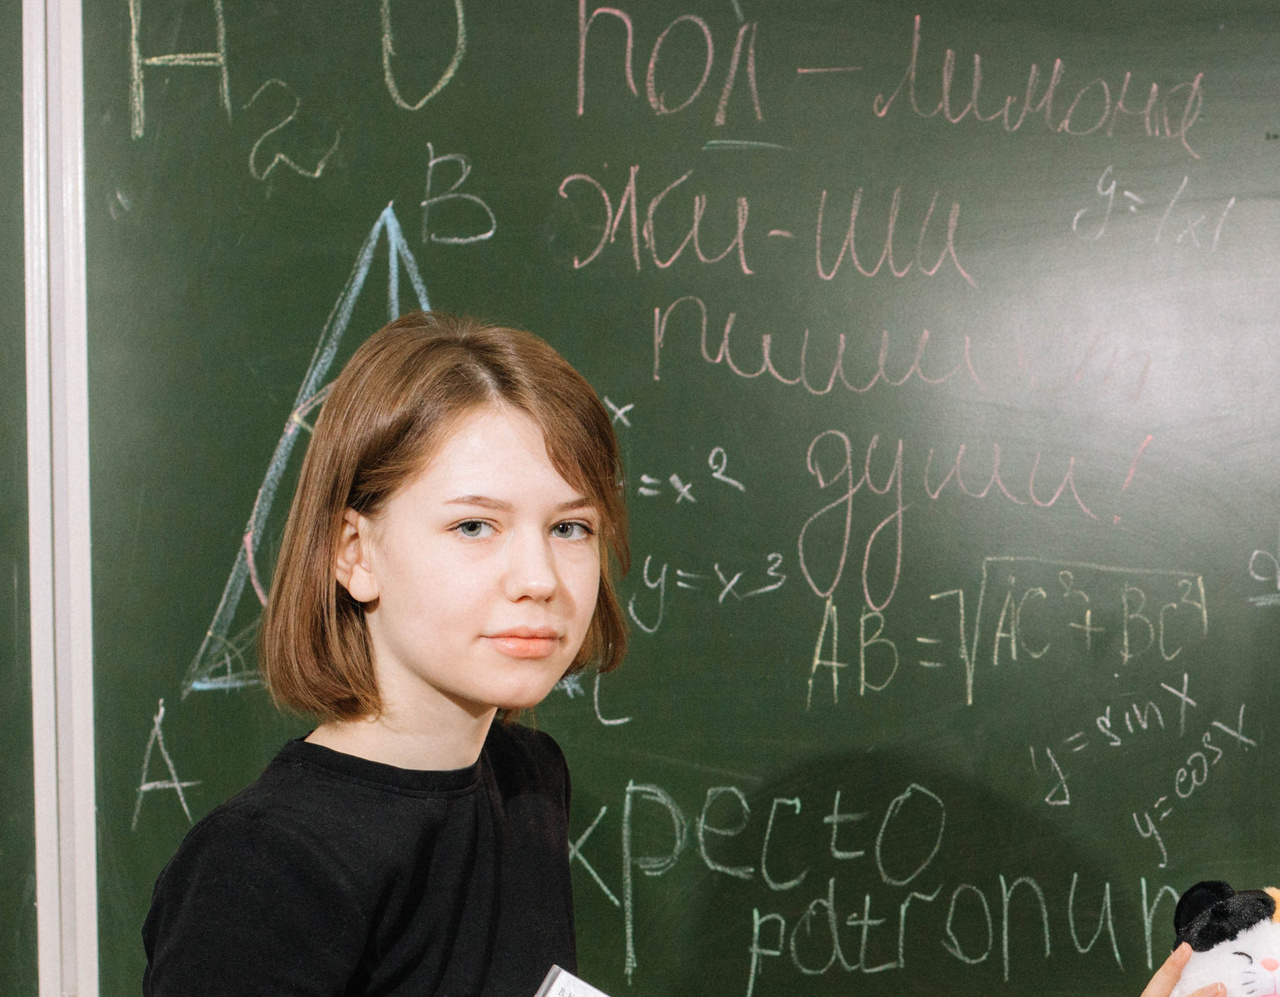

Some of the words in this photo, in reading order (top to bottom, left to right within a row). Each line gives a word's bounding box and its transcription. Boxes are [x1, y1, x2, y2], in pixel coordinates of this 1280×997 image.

[420, 141, 498, 244] B
[131, 697, 201, 832] A
[568, 779, 946, 986] xpecto
